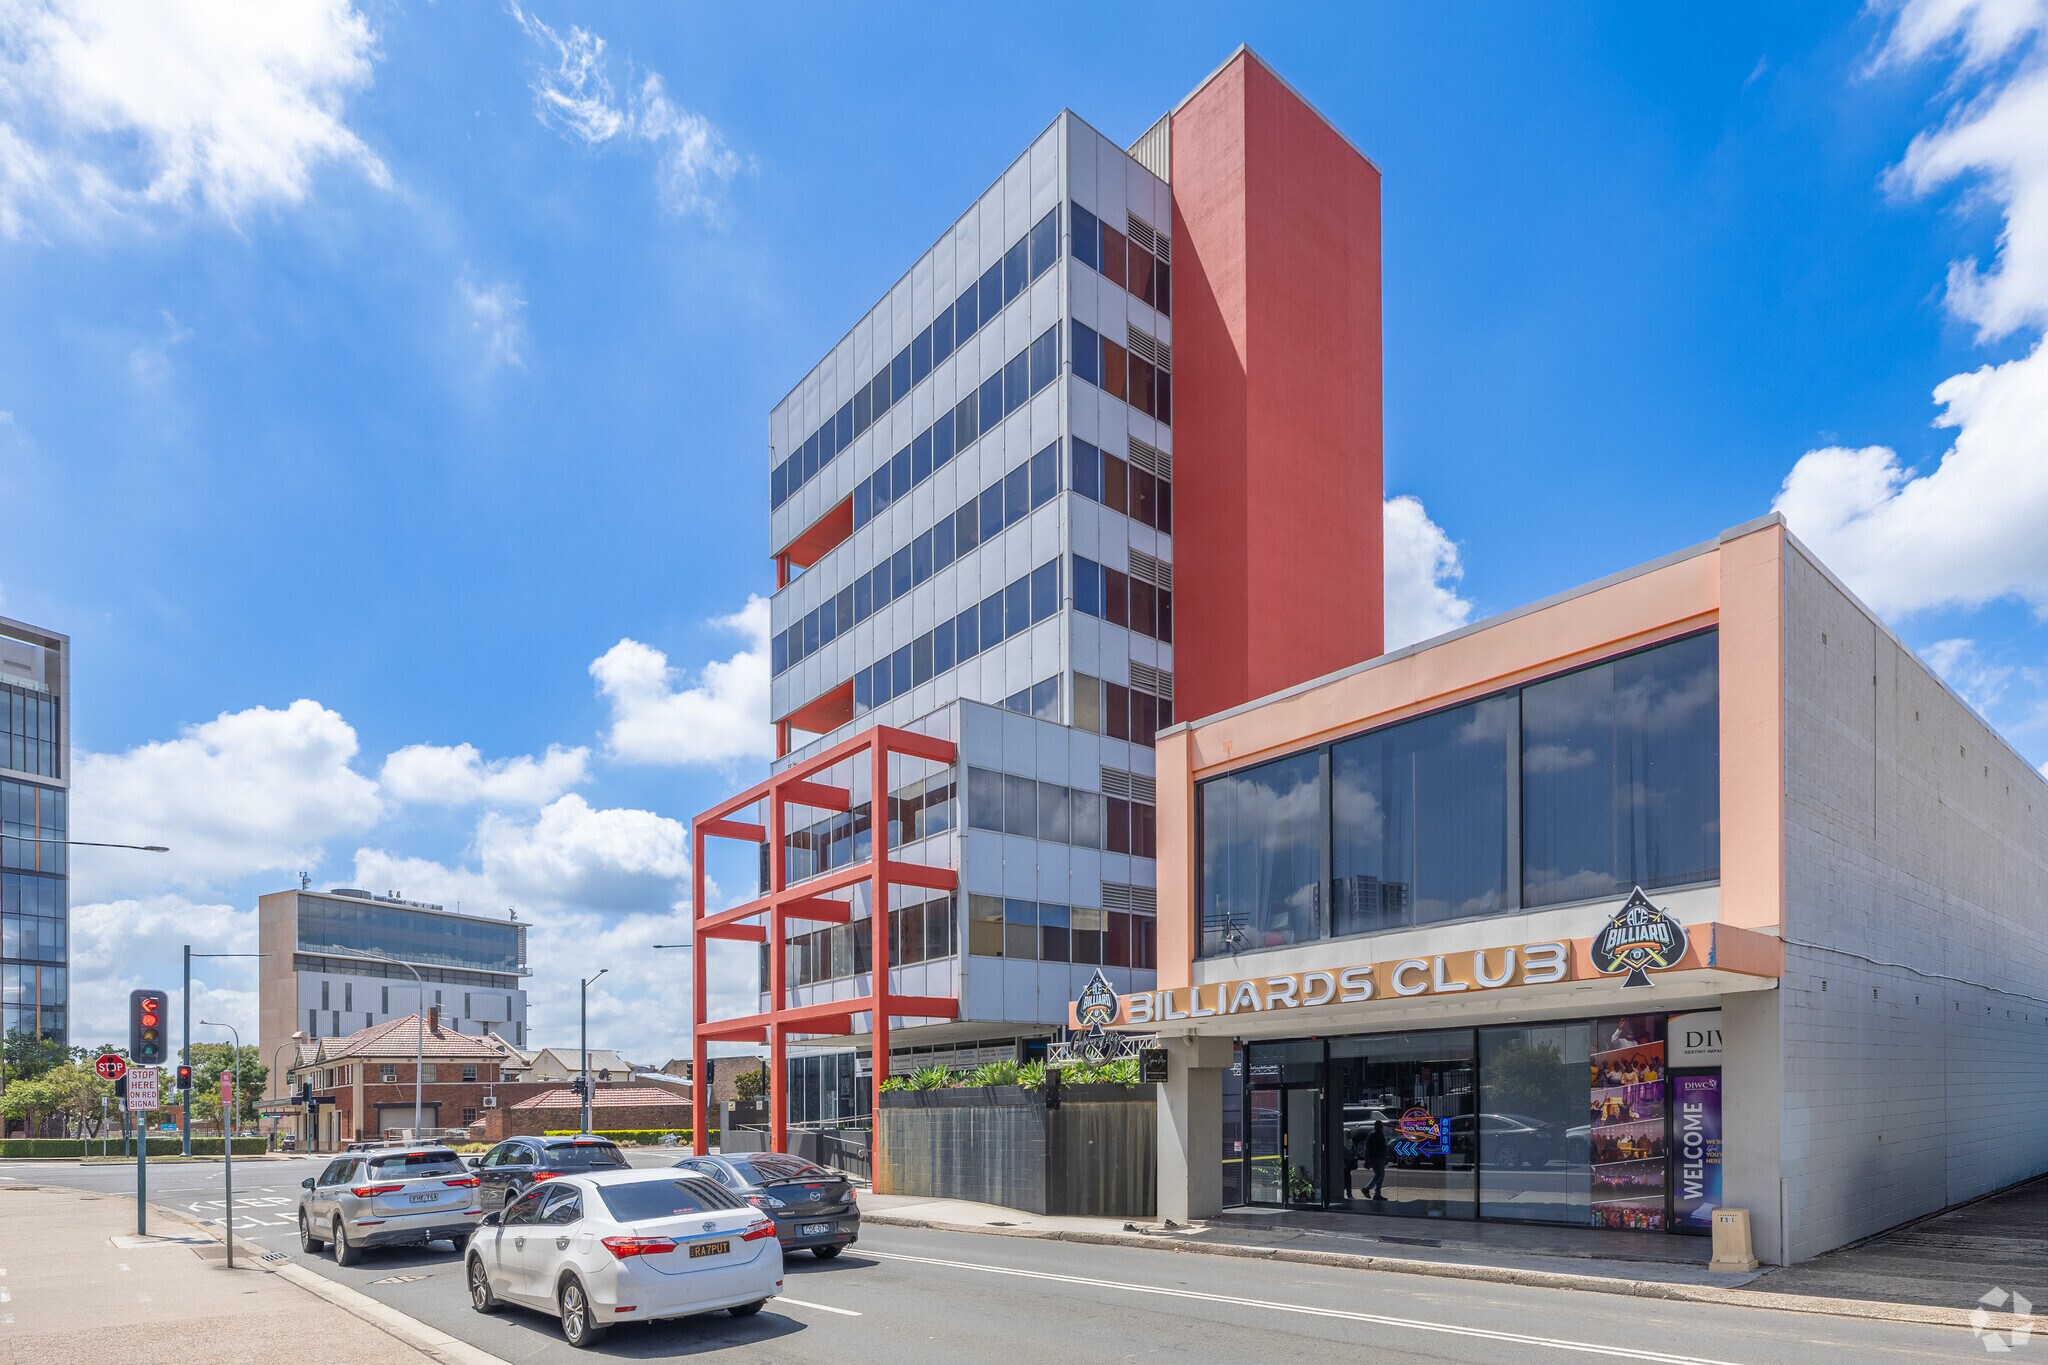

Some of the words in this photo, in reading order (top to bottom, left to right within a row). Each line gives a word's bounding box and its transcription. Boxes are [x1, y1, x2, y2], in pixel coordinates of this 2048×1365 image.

[1627, 907, 1649, 926] ACE
[1606, 922, 1670, 951] BILLIARD
[1128, 966, 1375, 1024] BILLIARDS
[1391, 942, 1568, 996] CLUB
[1083, 993, 1112, 1010] BILLIARD
[98, 1062, 124, 1072] STOP
[132, 1070, 155, 1079] STOP
[131, 1081, 155, 1090] HERE
[1684, 1081, 1709, 1089] DIWC
[130, 1091, 140, 1099] ON
[142, 1091, 157, 1099] RED
[130, 1100, 157, 1108] SIGNAL
[1441, 1118, 1449, 1153] OPEN
[1683, 1102, 1704, 1200] WELCOME
[695, 1243, 728, 1256] RA7PUT
